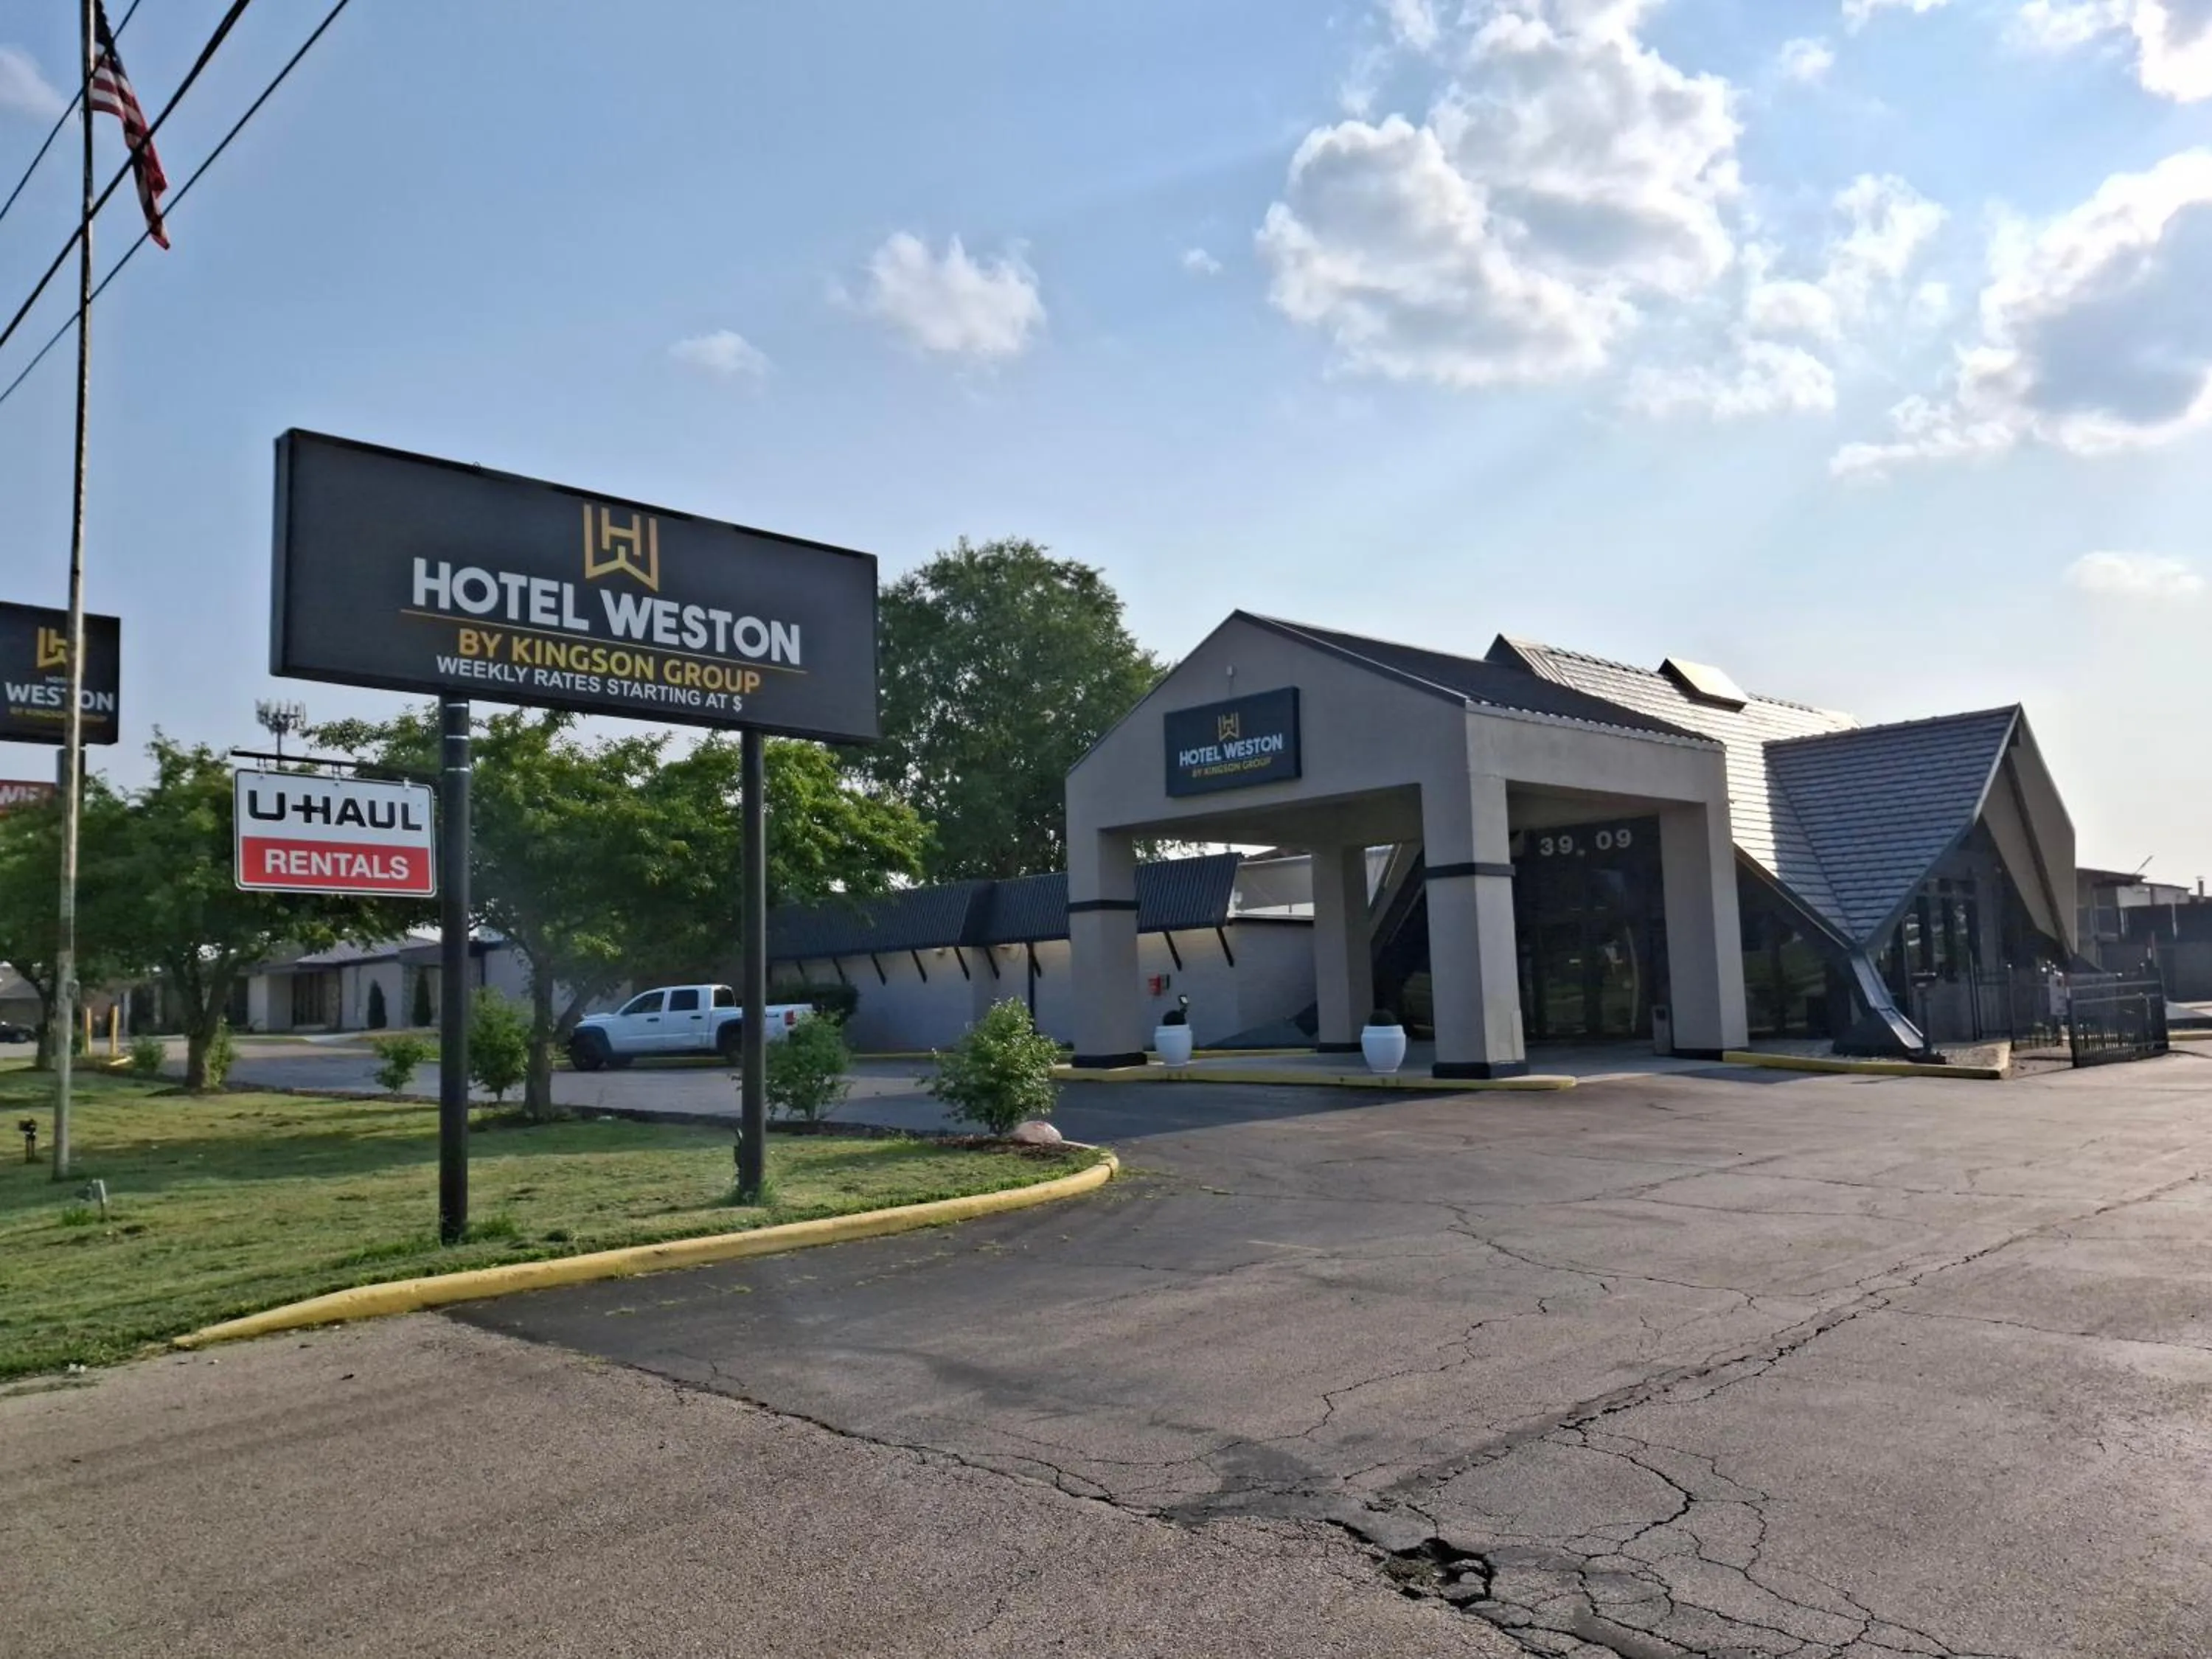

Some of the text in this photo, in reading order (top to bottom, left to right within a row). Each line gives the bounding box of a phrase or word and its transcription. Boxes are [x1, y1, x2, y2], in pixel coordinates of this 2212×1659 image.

[413, 557, 801, 665] HOTEL WESTON
[437, 655, 528, 683] WEEKLY
[534, 669, 601, 692] RATES
[607, 678, 701, 706] STARTING
[705, 692, 728, 709] AT
[459, 628, 761, 693] BY KINGSON GROUP
[1180, 733, 1283, 767] HOTEL WESTON
[248, 790, 422, 830] U-HAUL
[265, 849, 409, 880] RENTALS
